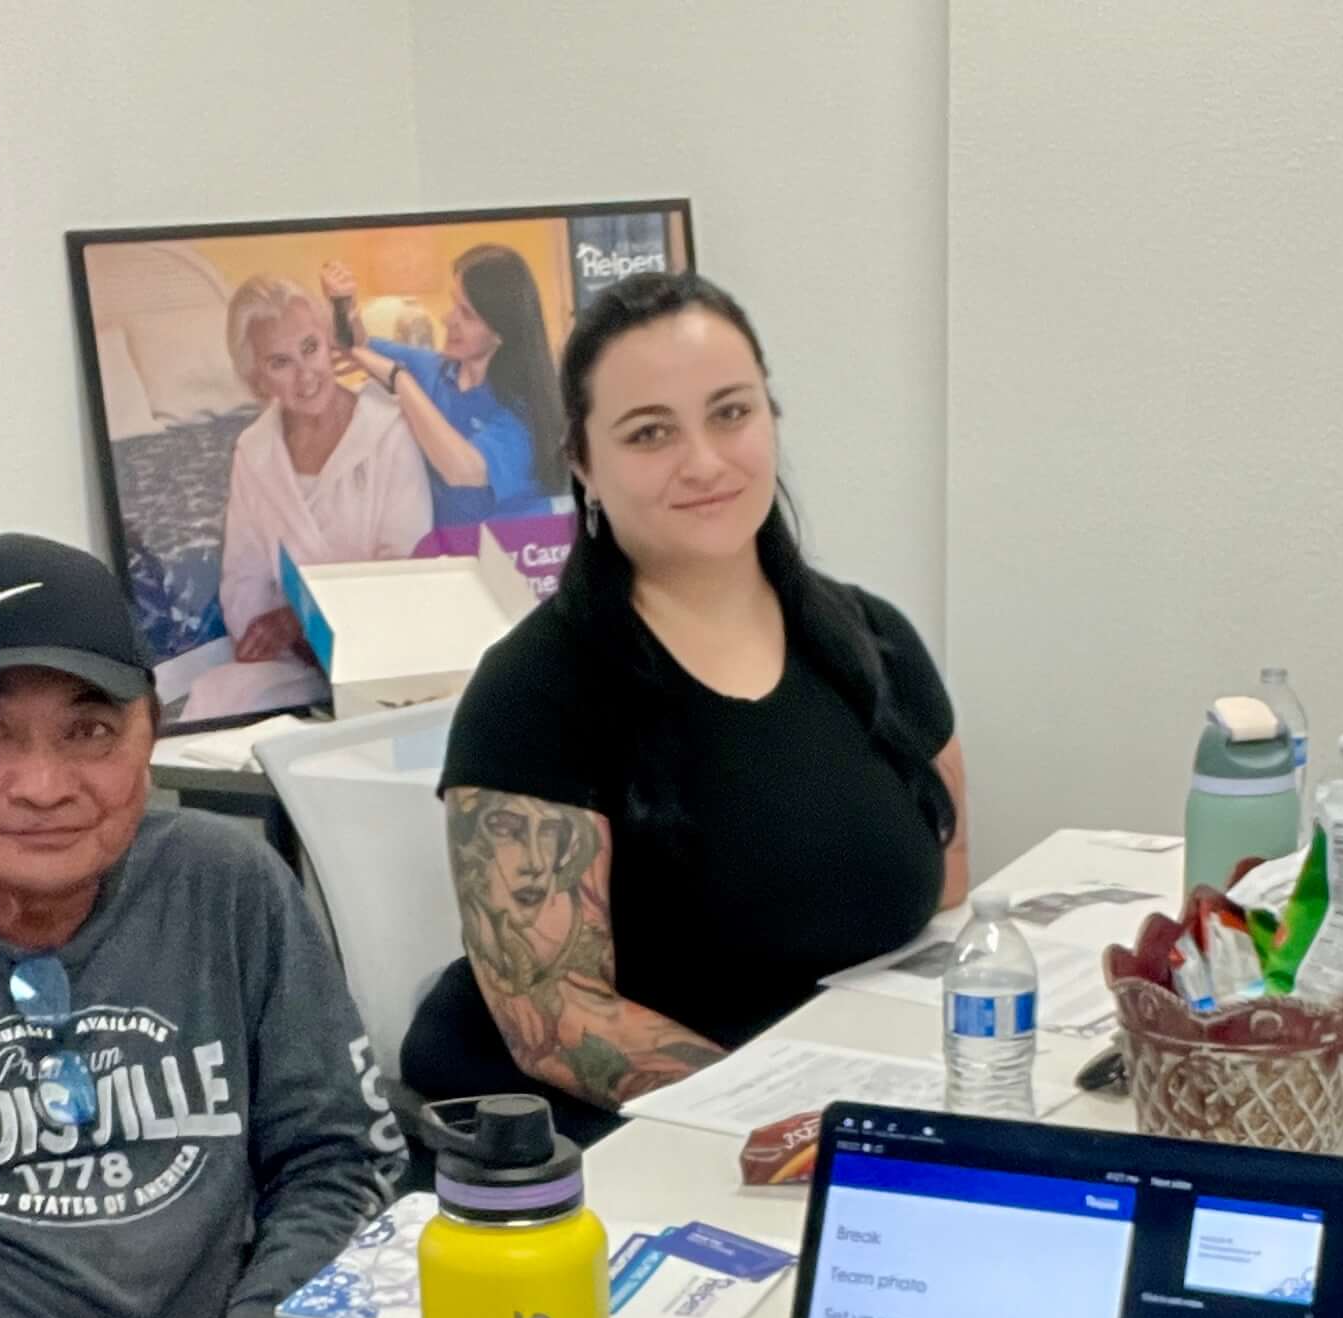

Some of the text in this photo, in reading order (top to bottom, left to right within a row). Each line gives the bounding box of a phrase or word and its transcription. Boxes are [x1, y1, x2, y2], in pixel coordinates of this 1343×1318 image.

[76, 1016, 169, 1043] AVAILABLE
[13, 1152, 133, 1193] 1778
[18, 1193, 98, 1216] STATES
[104, 1193, 126, 1215] OF
[134, 1144, 201, 1206] AMERICA
[836, 1225, 882, 1245] Break
[831, 1265, 927, 1294] Team photo
